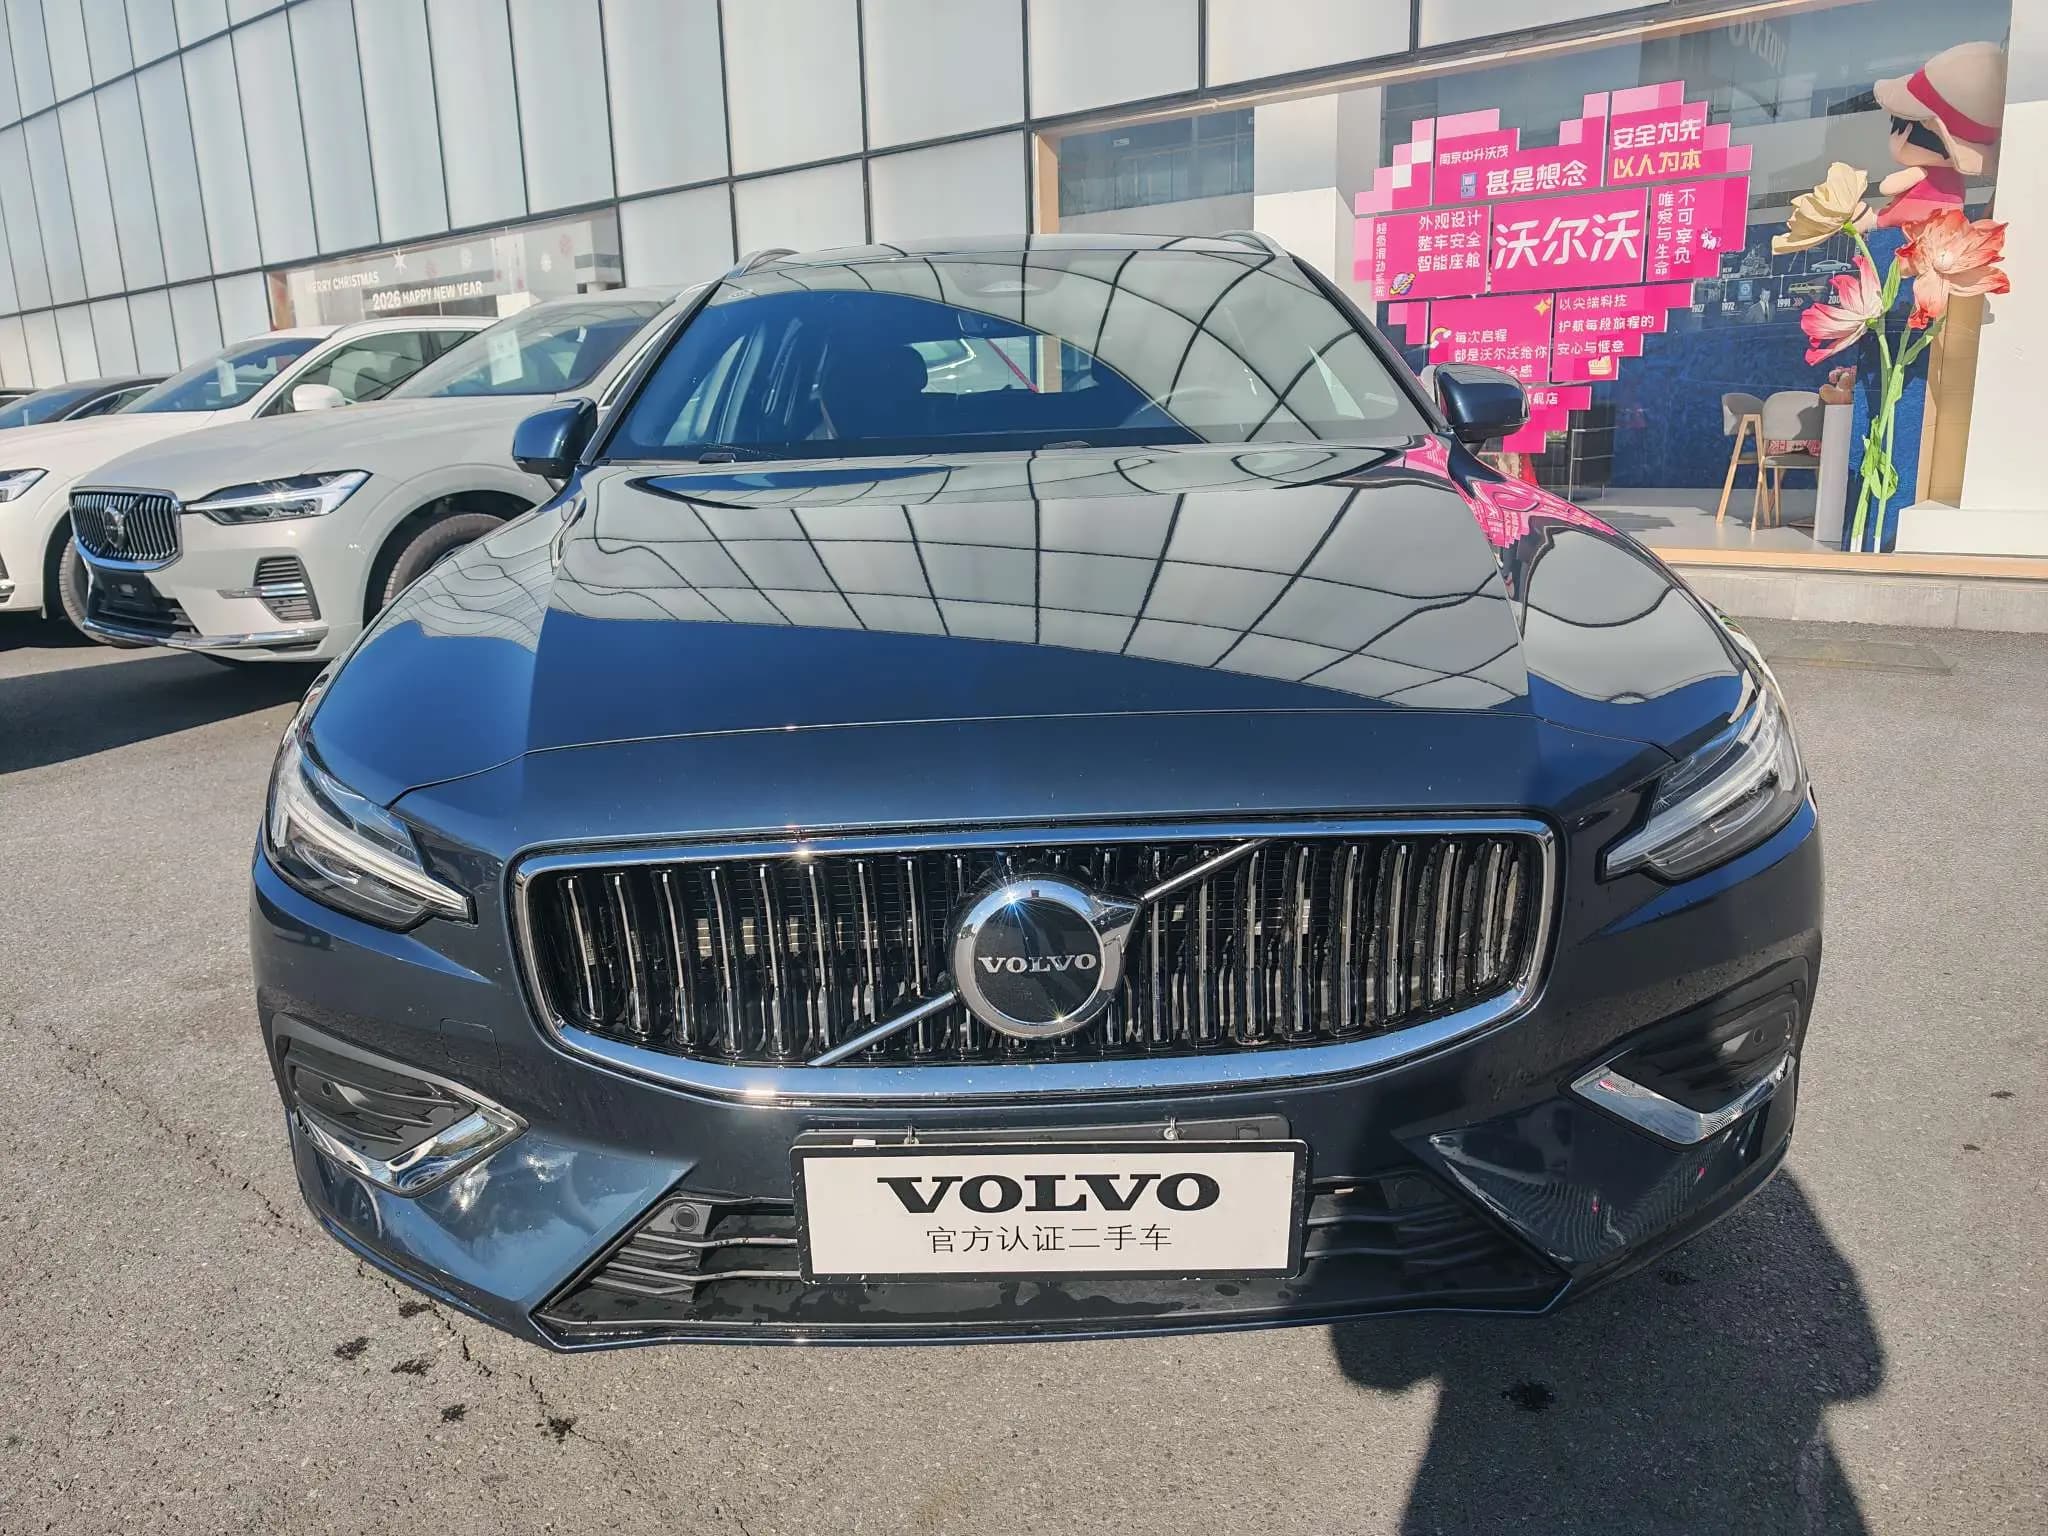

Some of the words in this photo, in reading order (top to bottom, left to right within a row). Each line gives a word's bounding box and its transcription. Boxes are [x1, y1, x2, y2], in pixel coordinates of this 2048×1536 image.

[1613, 118, 1701, 150] 安全为先
[1439, 144, 1509, 165] 南京中升沃茂
[1613, 148, 1702, 179] 以人为本
[1485, 159, 1588, 196] 甚是想念
[1418, 209, 1482, 231] 外观设计
[1417, 231, 1481, 252] 整车安全
[1494, 209, 1641, 269] 沃尔沃
[1654, 191, 1675, 277] 唯爱与生命
[1416, 251, 1481, 272] 智能座舱
[332, 271, 380, 291] CHRISTMAS
[372, 289, 401, 311] 2026
[402, 287, 432, 304] HAPPY
[433, 283, 456, 300] NEW
[456, 280, 483, 298] YEAR
[1559, 294, 1628, 311] 以尖端科技
[1828, 295, 1840, 304] 200
[1558, 315, 1655, 333] 护航每段旅程的
[1455, 328, 1508, 344] 每次启程
[1454, 345, 1548, 362] 都是沃尔沃给你
[1493, 364, 1533, 378] 全感
[978, 953, 1097, 974] VOLVO
[876, 1172, 1221, 1214] VOLVO
[926, 1223, 1173, 1253] 官方认证二手车
